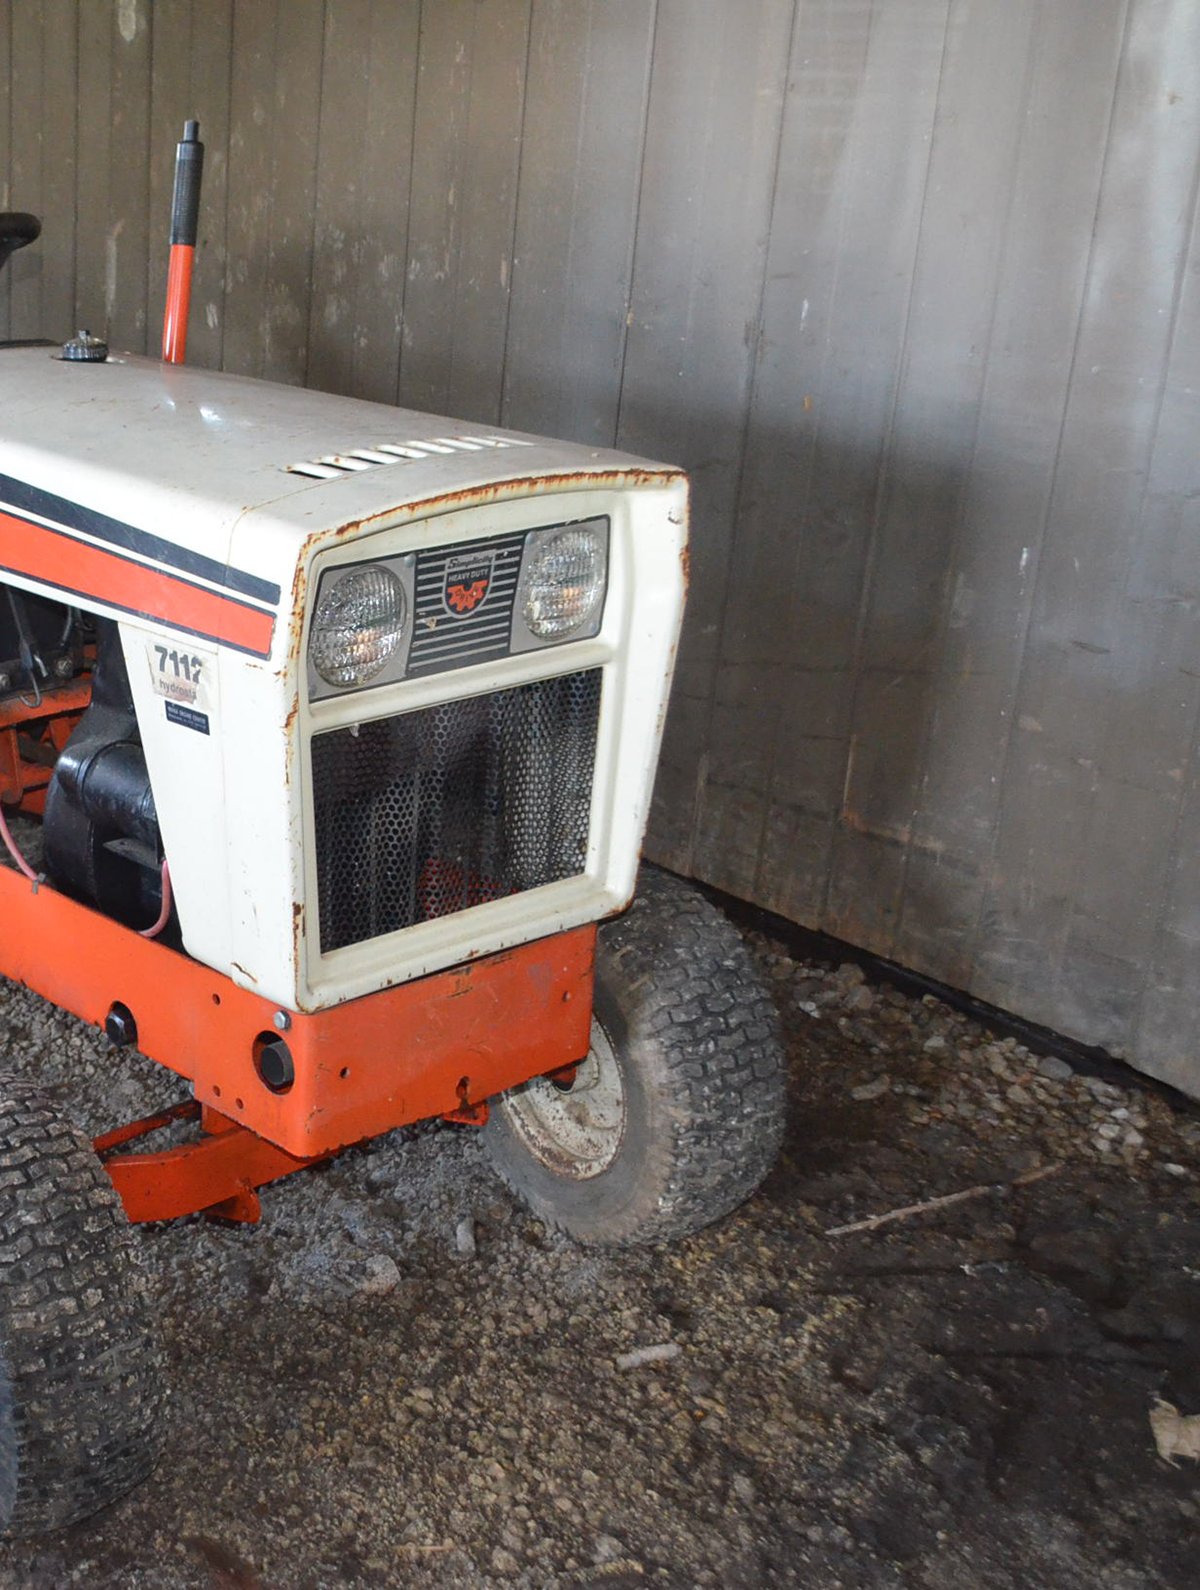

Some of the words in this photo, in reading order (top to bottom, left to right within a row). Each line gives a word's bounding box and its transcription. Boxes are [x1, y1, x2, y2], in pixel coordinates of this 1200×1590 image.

[447, 555, 493, 570] Simplicity
[448, 572, 470, 582] HEAVY
[470, 568, 489, 578] DUTY
